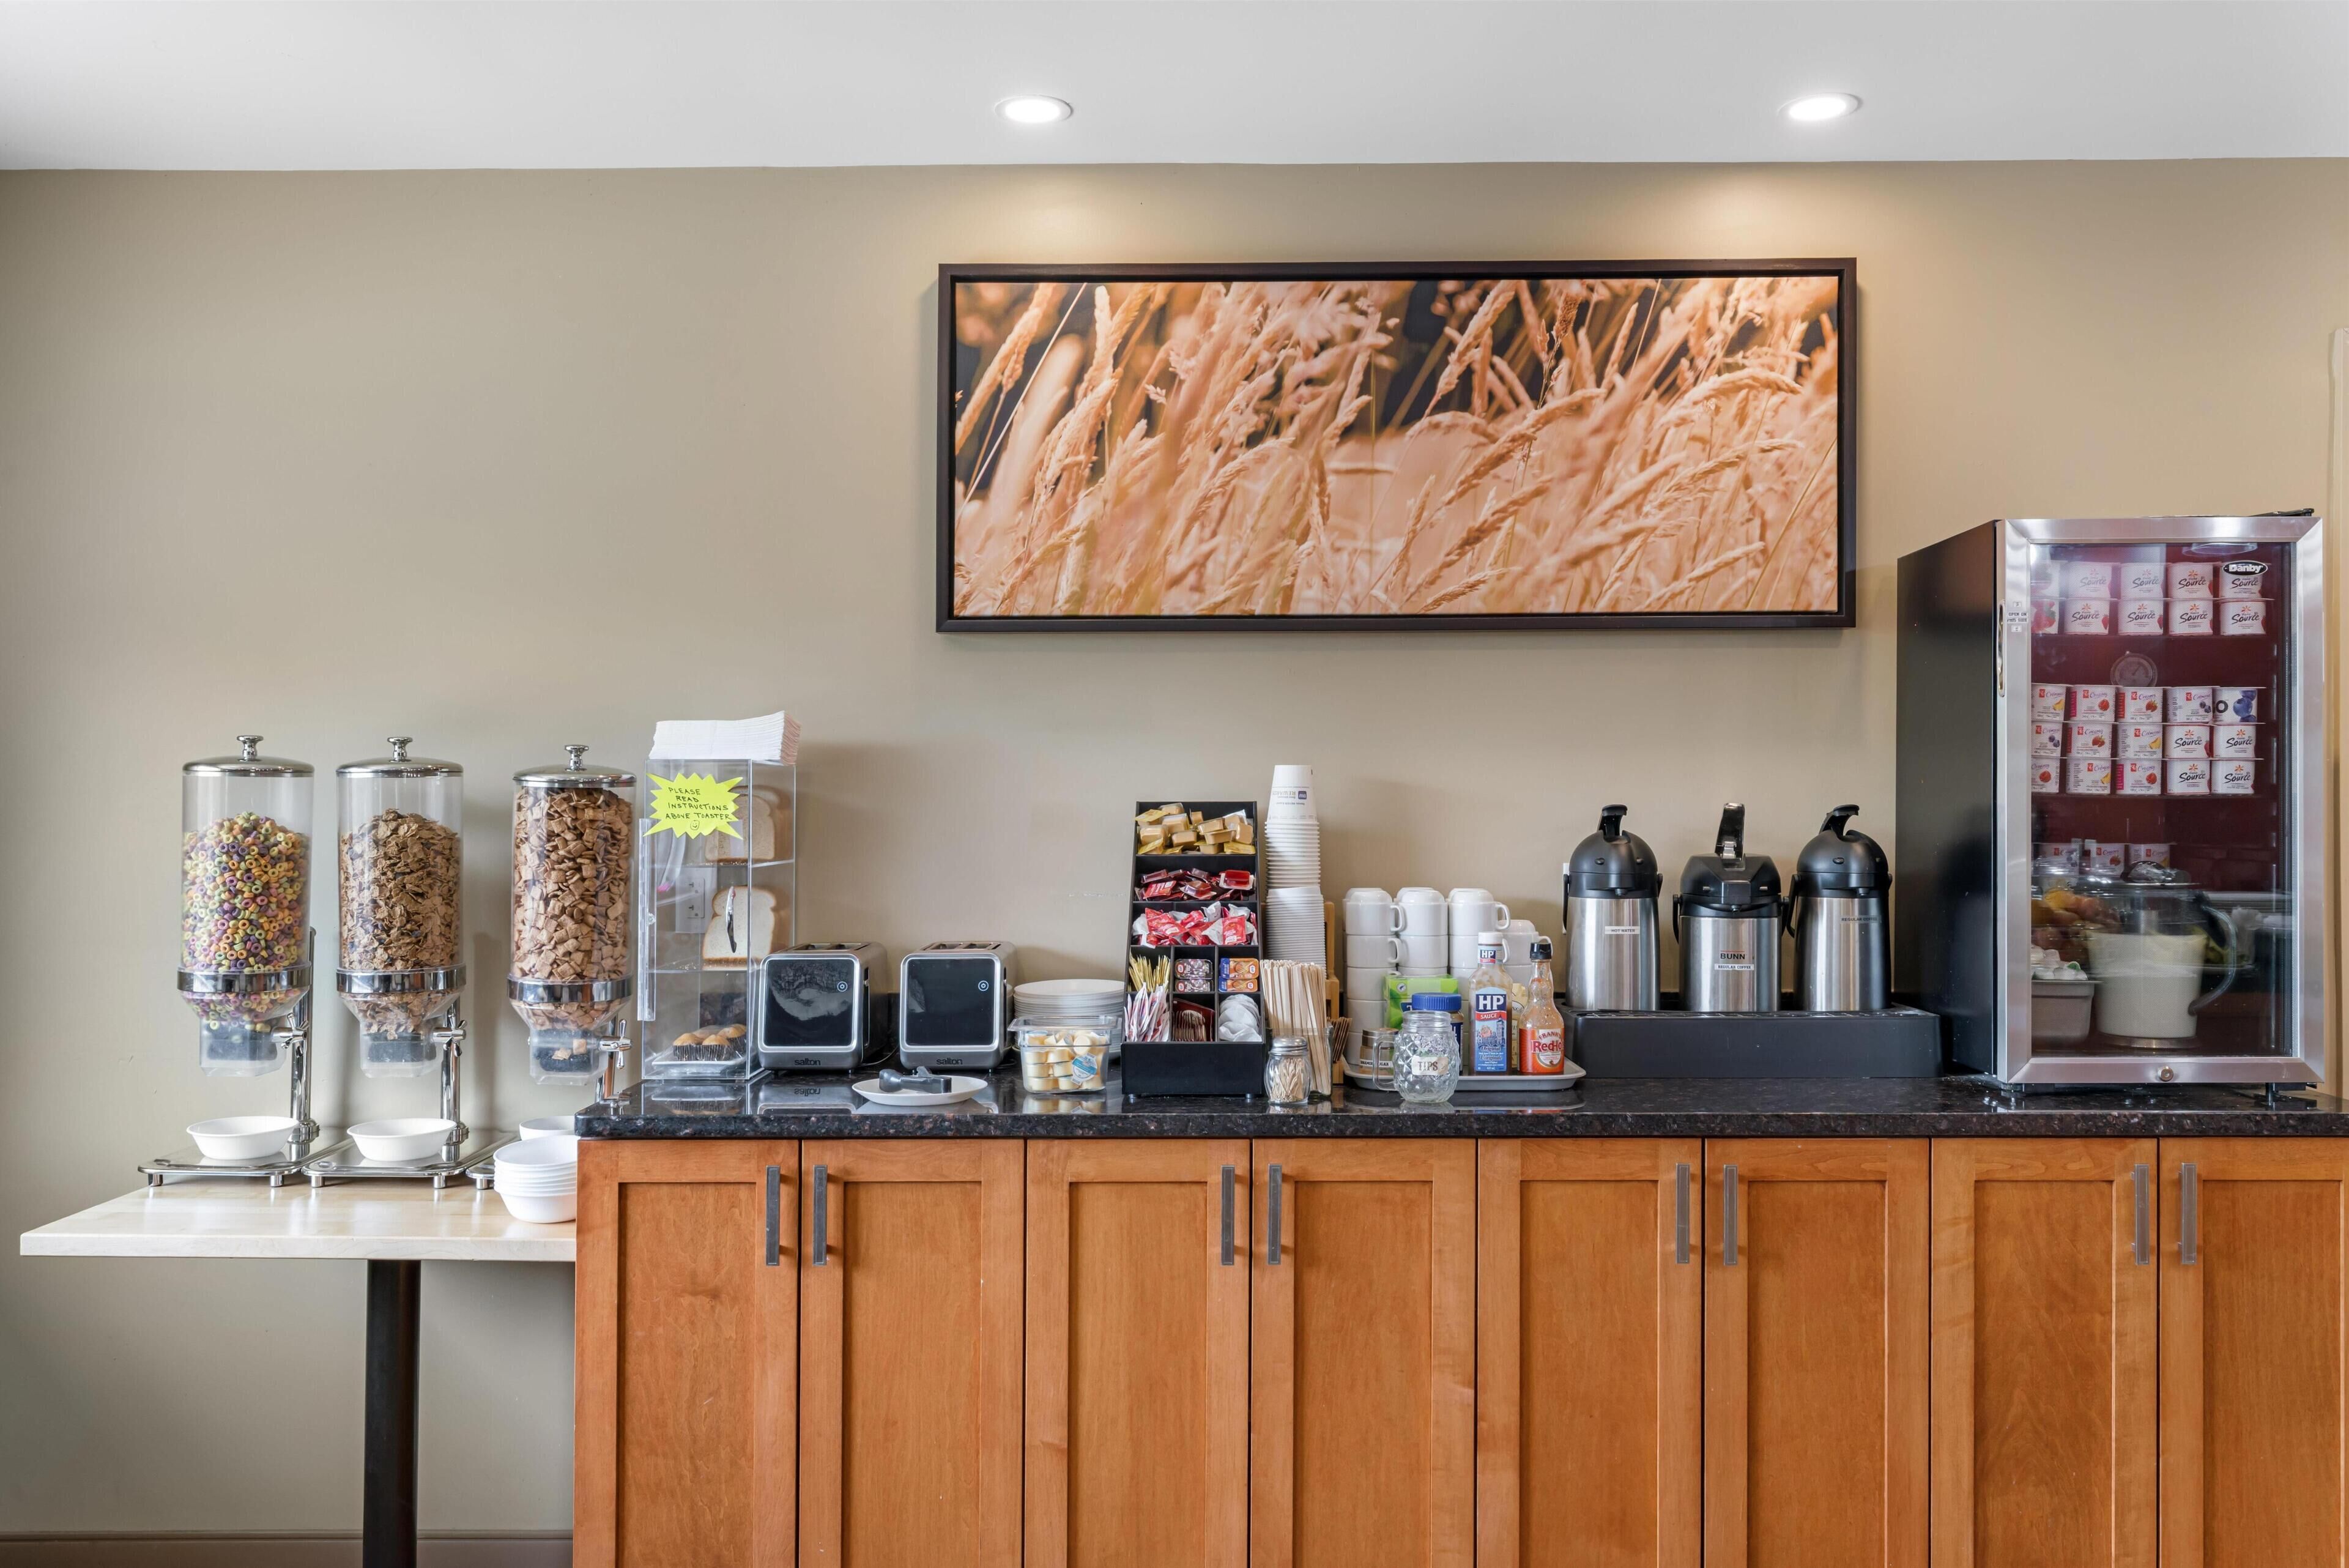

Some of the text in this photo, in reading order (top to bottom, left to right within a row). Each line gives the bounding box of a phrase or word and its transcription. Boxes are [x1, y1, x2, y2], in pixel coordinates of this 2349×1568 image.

[2228, 563, 2262, 573] Danby
[2131, 578, 2159, 589] Source
[2178, 578, 2206, 590] Source
[2230, 578, 2258, 589] Source
[2071, 612, 2100, 623] Source
[2127, 612, 2156, 623] Source
[2179, 613, 2208, 624] Source
[2232, 614, 2260, 625] Source
[2173, 737, 2203, 749] Source
[2225, 737, 2254, 749] Source
[2179, 772, 2206, 783] Source
[2223, 773, 2251, 784] Source
[668, 802, 729, 811] INSTRUCTIONS
[1479, 995, 1504, 1010] HP
[1418, 1061, 1438, 1071] TIPS
